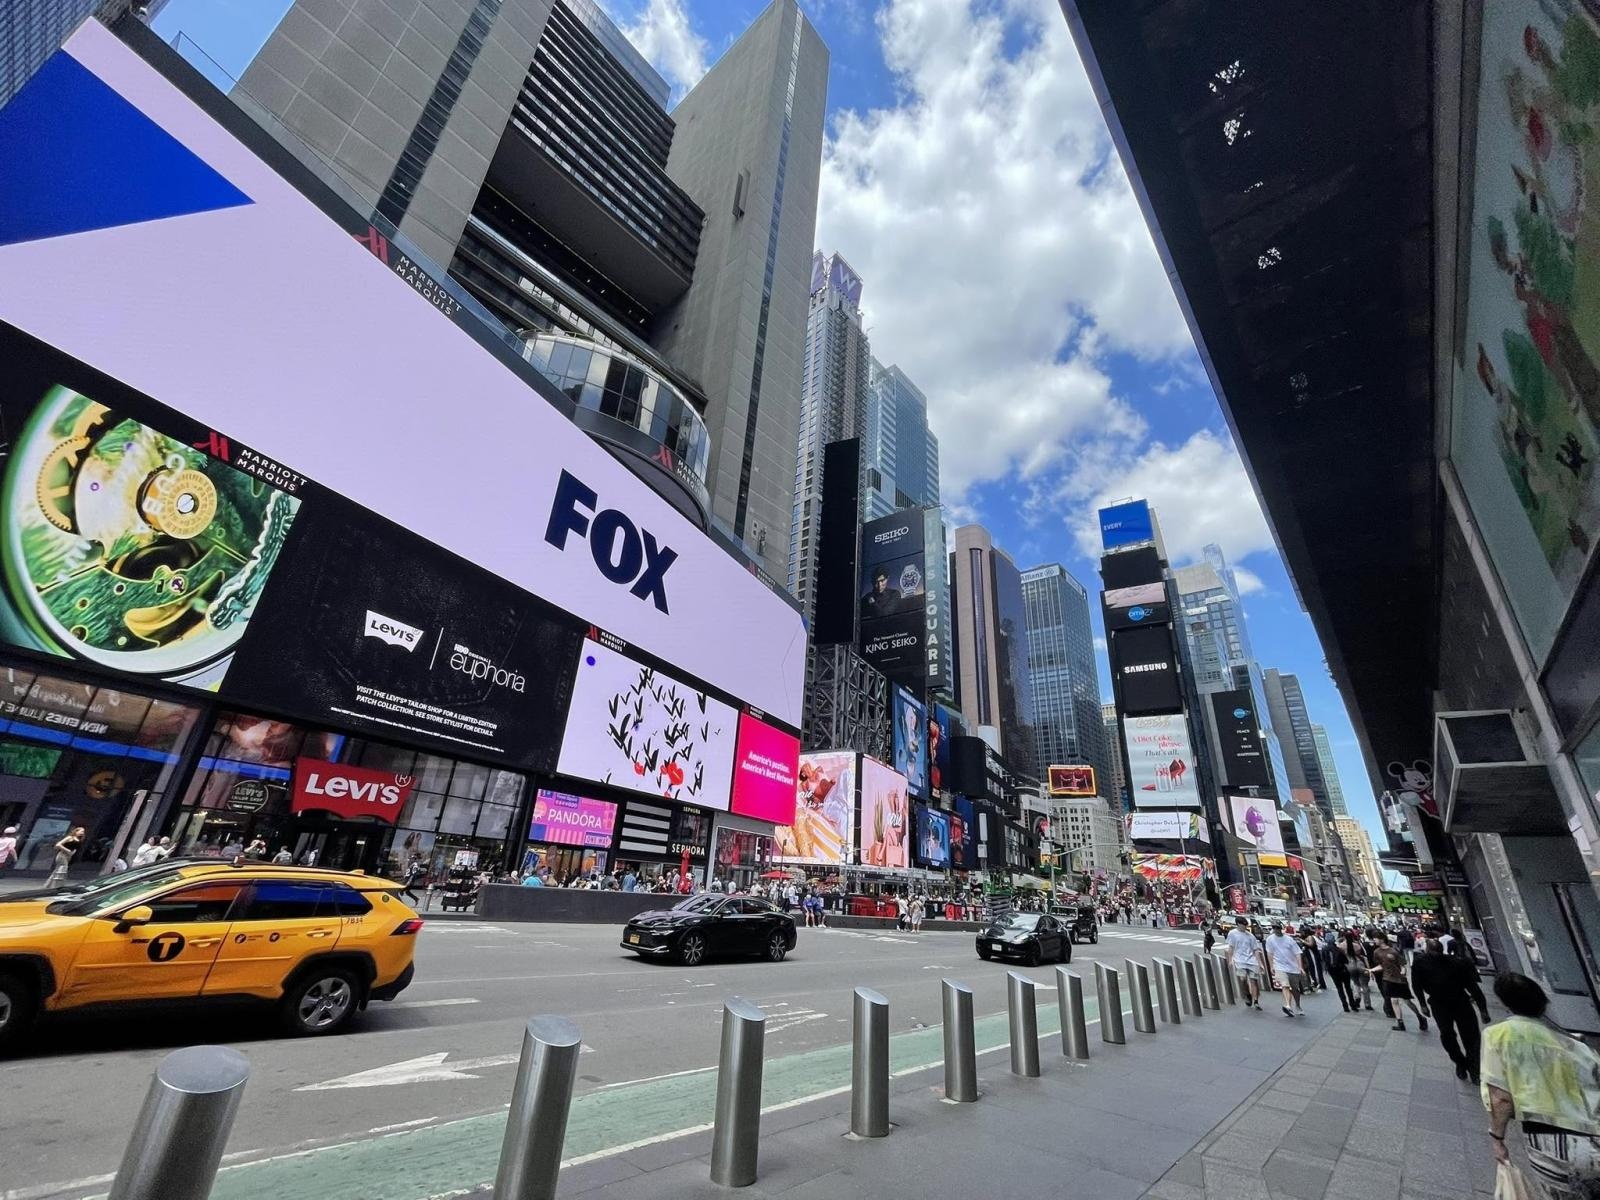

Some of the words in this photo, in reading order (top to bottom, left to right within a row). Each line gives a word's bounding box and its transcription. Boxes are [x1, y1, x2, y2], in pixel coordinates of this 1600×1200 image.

[396, 265, 452, 315] MARQUIS
[400, 256, 462, 312] MARRIOTT
[237, 458, 296, 492] MARQUIS
[241, 449, 308, 486] MARRIOTT
[544, 468, 679, 616] FOX
[874, 526, 909, 543] SEIKO
[1021, 571, 1044, 582] Allianz
[601, 631, 627, 648] MARRIOTT
[926, 590, 939, 677] SQUARE
[600, 637, 623, 652] MARQUIS
[865, 641, 889, 654] KING
[891, 636, 918, 649] SEIKO
[450, 653, 526, 693] euphoria
[1124, 662, 1168, 674] SAMSUNG
[356, 685, 373, 695] VISIT
[373, 689, 386, 699] THE
[407, 699, 428, 710] TAILOR
[427, 705, 443, 714] SHOP
[443, 709, 454, 717] FOR
[356, 694, 378, 706] PATCH
[414, 710, 427, 719] SEE
[426, 713, 444, 724] STORE
[443, 718, 464, 729] STYLIST
[463, 723, 474, 732] FOR
[742, 760, 766, 776] America's
[748, 750, 772, 767] America's
[547, 808, 602, 829] PANDORA
[682, 806, 701, 815] SEPHORA
[671, 843, 706, 857] SEPHORA
